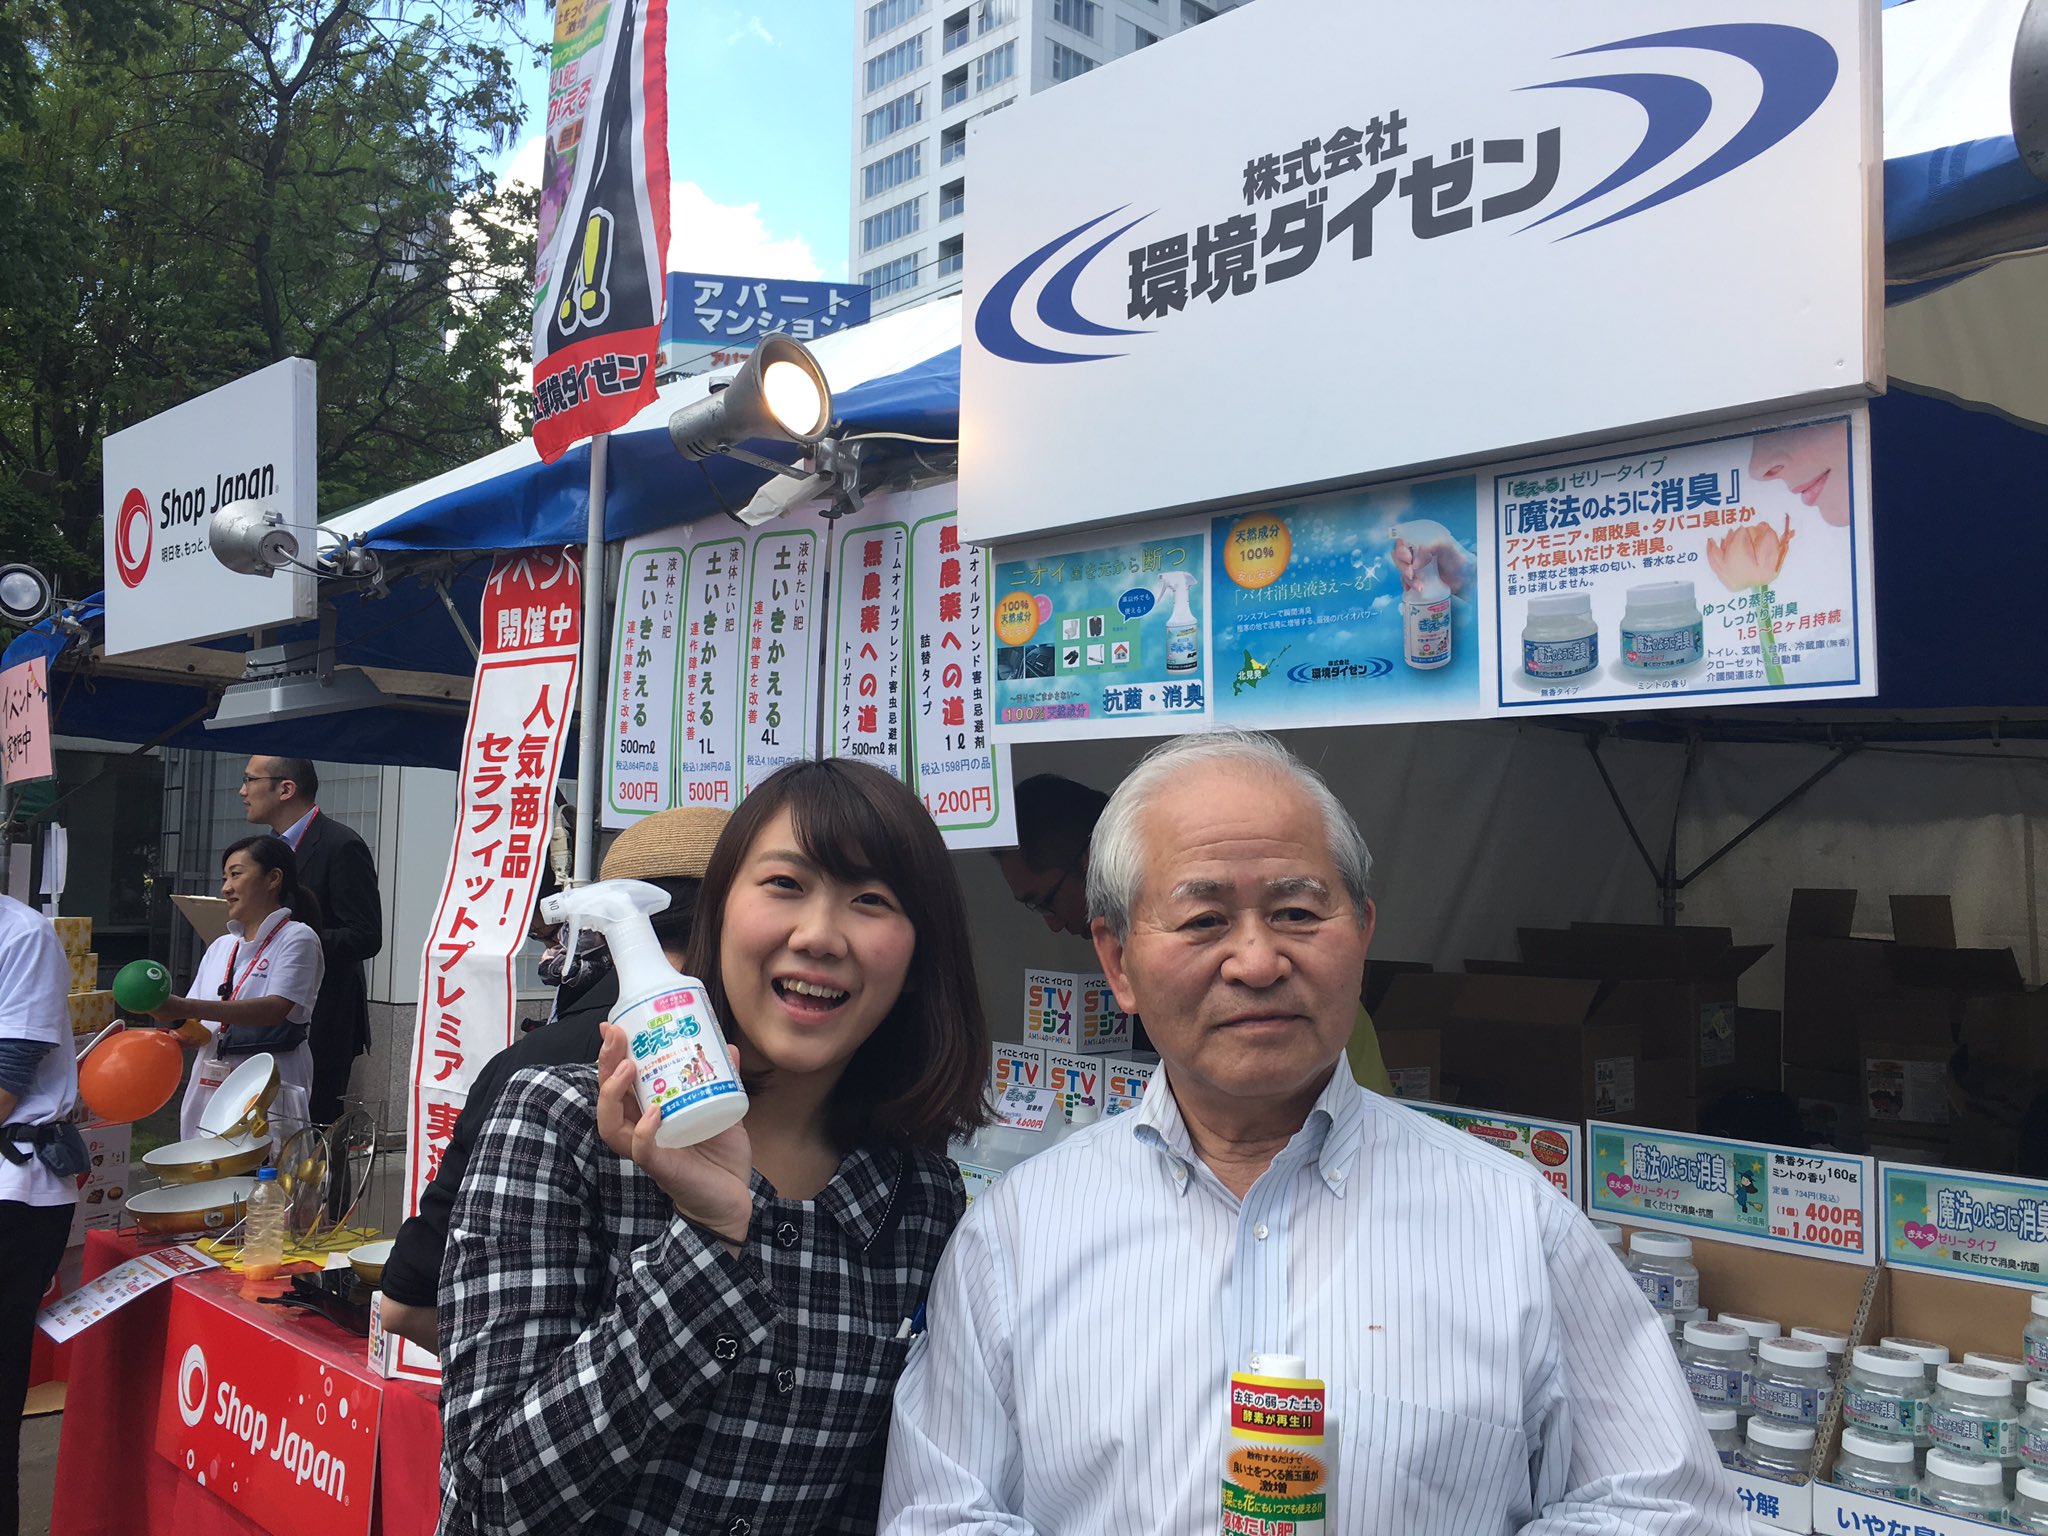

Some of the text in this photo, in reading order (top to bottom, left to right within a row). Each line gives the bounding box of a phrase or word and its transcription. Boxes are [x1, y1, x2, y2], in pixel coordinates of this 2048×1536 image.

[1242, 108, 1408, 205] 株式会社
[1125, 126, 1562, 322] 環境ダイゼン
[694, 280, 851, 317] アパート
[160, 463, 274, 529] Shop Japan
[1504, 468, 1741, 536] 『魔法のように消臭』
[1235, 524, 1280, 544] 天然成分
[1240, 546, 1274, 561] 100%
[1506, 536, 1675, 571] イヤな臭いだけを消臭。
[662, 557, 678, 640] 液体たい肥
[725, 547, 740, 632] 液体たい肥
[793, 541, 810, 631] 液体たい肥
[1508, 578, 1595, 596] 香りは消しません。
[1002, 600, 1029, 612] 100%
[1702, 590, 1776, 617] ゆっくり蒸発
[1723, 602, 1799, 629] しっかり消臭
[497, 602, 573, 649] 開催中
[939, 525, 965, 727] 無農薬への道
[1000, 611, 1032, 625] 天然成分
[633, 559, 659, 727] 土いきかえる
[700, 551, 722, 727] 土いきかえる
[766, 545, 792, 729] 土いきかえる
[857, 540, 884, 734] 無農薬への道
[888, 530, 904, 756] ニームオイルブレンド害虫忌避剤
[748, 600, 764, 724] 連作障害を改善
[920, 634, 934, 716] 詰替タイプ
[1311, 665, 1368, 680] 環境ダイゼン
[619, 620, 637, 735] 連作障害を改善
[686, 622, 700, 741] 連作障害を改善
[1237, 670, 1262, 681] 北見発
[1637, 678, 1687, 690] ミントの香り
[1706, 670, 1764, 682] 介護関連ほか
[841, 641, 852, 750] トリガータイプ
[1102, 682, 1205, 712] 抗菌・消臭
[1540, 686, 1580, 697] 無香タイプ
[699, 738, 715, 754] 1L
[761, 728, 780, 746] 4L
[615, 761, 659, 772] 税込864円の品
[920, 756, 991, 776] 税込1598円の品
[619, 781, 658, 803] 300円
[688, 780, 729, 803] 500円
[923, 786, 992, 818] 1,200円
[1029, 975, 1073, 987] イイこと イロイロ
[1084, 980, 1106, 988] イイこと
[1029, 985, 1073, 1011] STV
[1028, 1009, 1072, 1036] ラジオ
[1083, 1011, 1129, 1038] ラジオ
[997, 1048, 1040, 1061] イイこと イロイロ
[1051, 1057, 1097, 1071] イイこと イロイロ
[996, 1058, 1039, 1085] STV
[1051, 1067, 1097, 1096] STV
[1111, 1065, 1134, 1076] イイこと
[1110, 1076, 1147, 1097] ST
[1632, 1143, 1727, 1193] 魔法のように消臭
[1775, 1154, 1825, 1169] 無香タイプ
[1772, 1167, 1858, 1184] ミントの香り 160g
[1633, 1183, 1680, 1200] ゼリータイプ
[1772, 1186, 1790, 1196] 定価
[1805, 1202, 1863, 1228] 400円
[1938, 1233, 1997, 1252] ゼリータイプ
[1952, 1250, 2040, 1273] 置くだけで消臭・抗菌
[1234, 1390, 1322, 1412] 去年の弱った土も
[213, 1380, 346, 1503] Shop Japan
[1247, 1451, 1303, 1464] 散布するだけで
[1259, 1480, 1288, 1494] 激増
